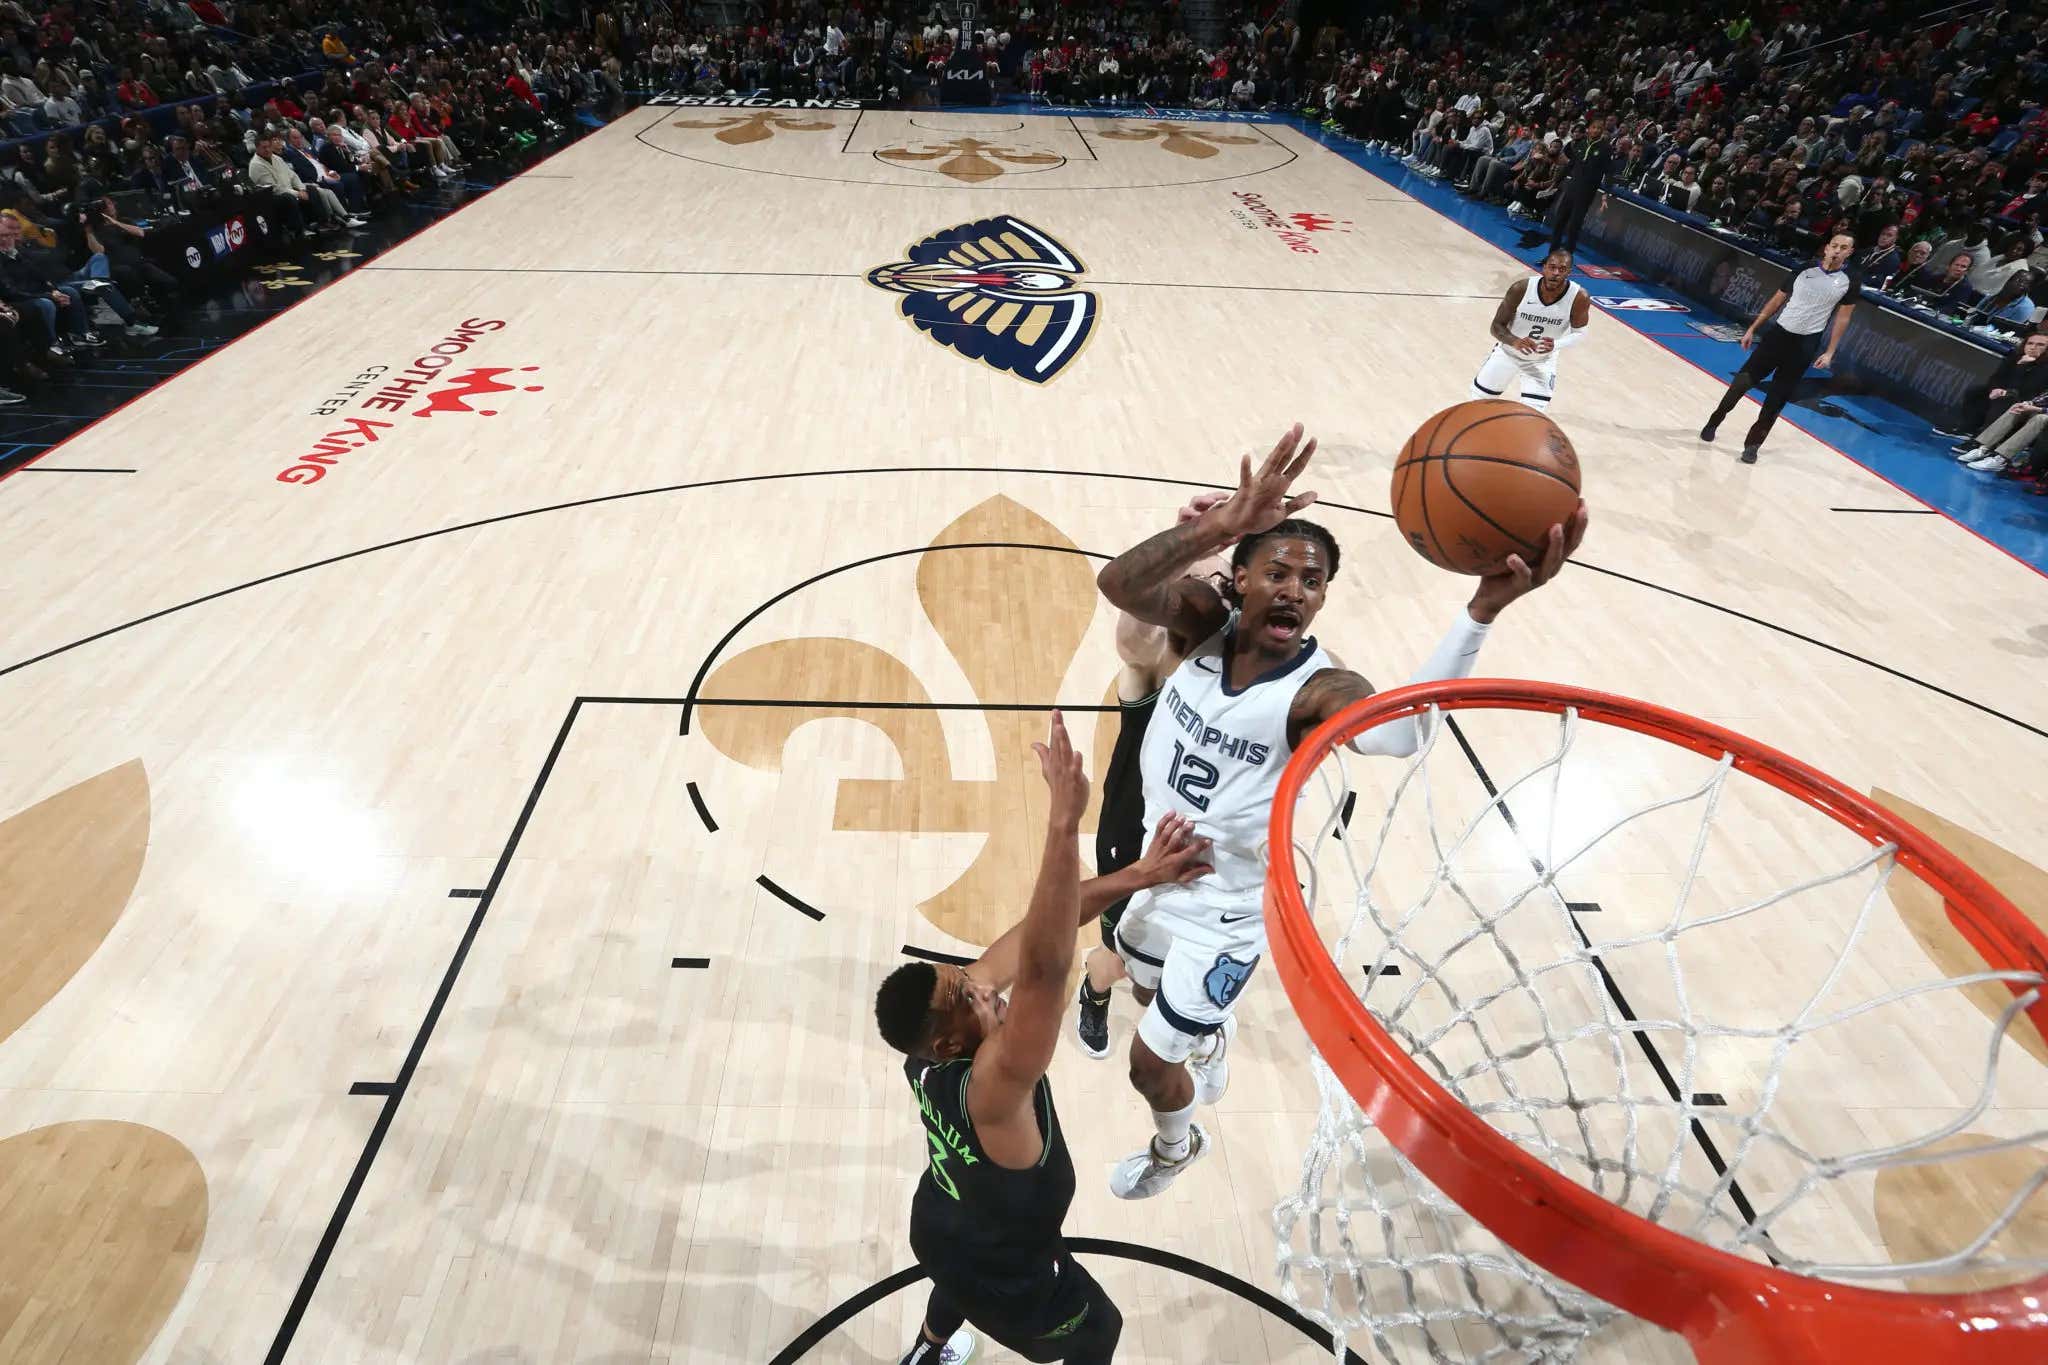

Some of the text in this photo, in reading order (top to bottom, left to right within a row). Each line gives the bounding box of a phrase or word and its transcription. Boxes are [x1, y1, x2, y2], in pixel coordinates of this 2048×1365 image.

[946, 69, 984, 80] KIA
[646, 96, 862, 109] PELICANS
[1232, 191, 1291, 229] SMOOTHIE
[1519, 311, 1563, 327] MEMPHIS
[1528, 325, 1545, 340] 2
[361, 317, 506, 413] SMOOTHIE
[310, 365, 389, 416] CENTER
[1165, 685, 1270, 766] MEMPHIS
[1167, 738, 1220, 813] 12
